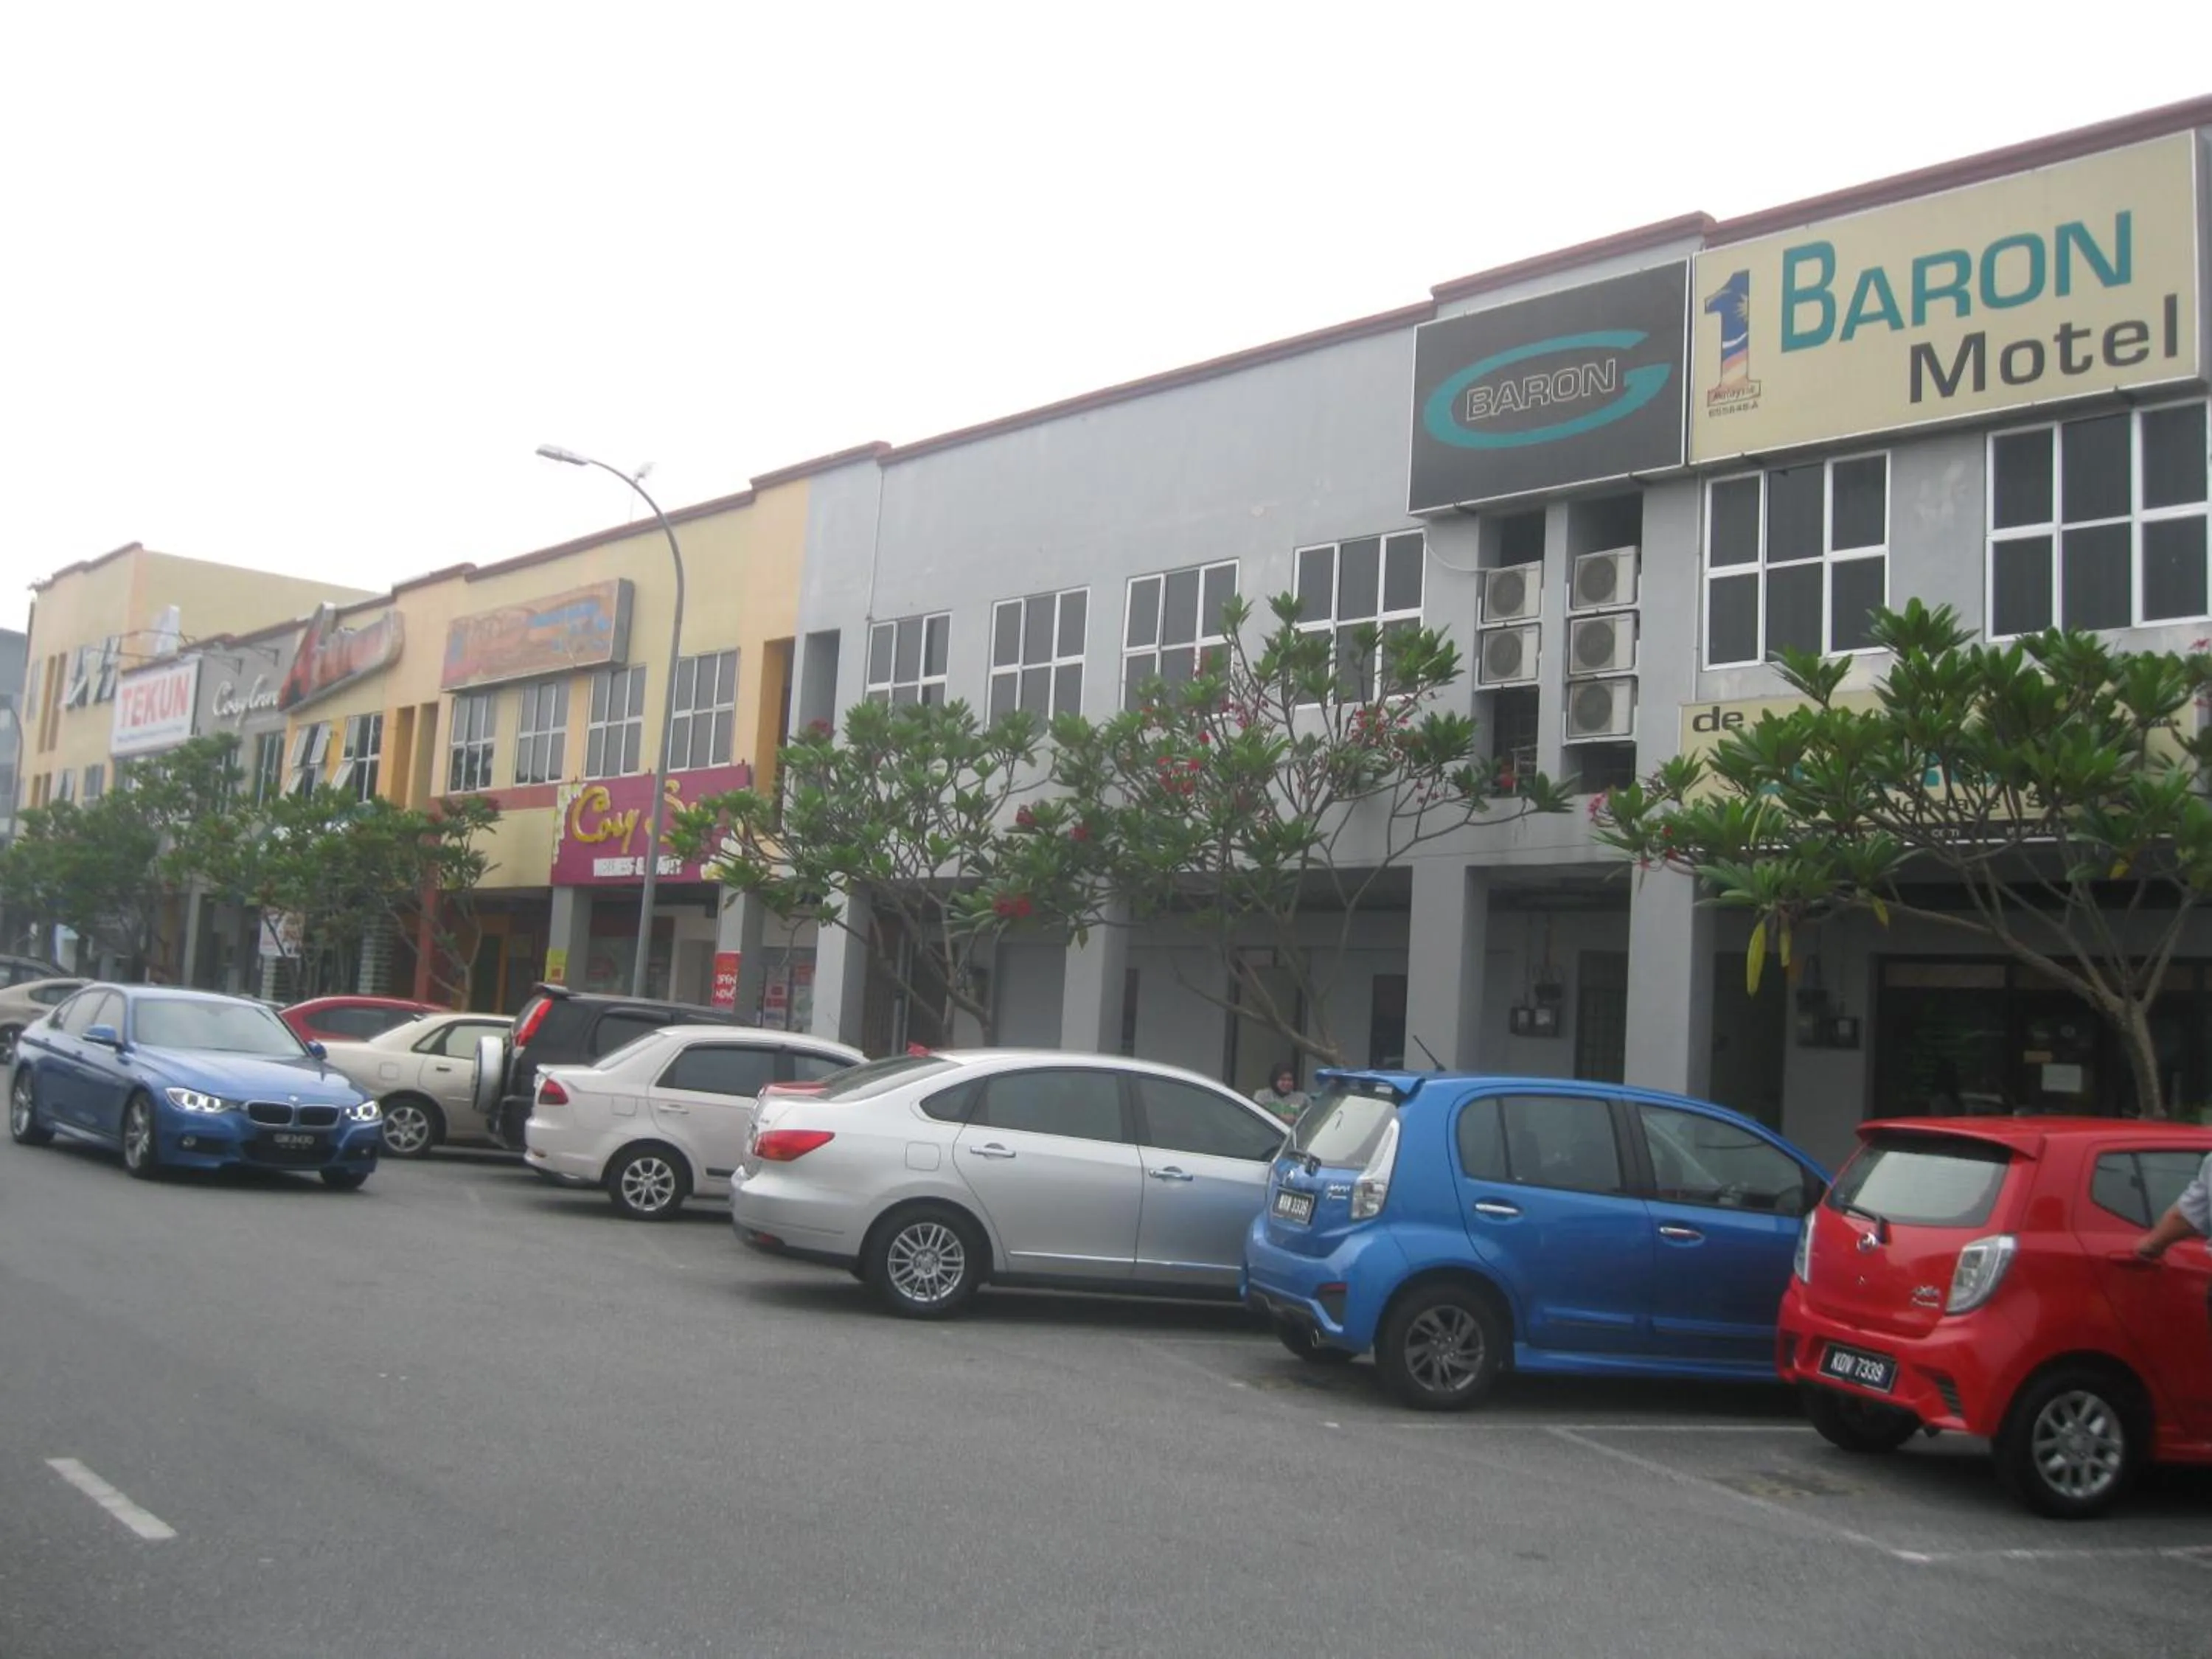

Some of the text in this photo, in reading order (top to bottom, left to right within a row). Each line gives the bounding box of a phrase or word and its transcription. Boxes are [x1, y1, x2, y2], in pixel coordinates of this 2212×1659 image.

[1781, 210, 2132, 354] BARON
[1910, 293, 2179, 403] Motel
[1466, 358, 1616, 421] BARON
[121, 672, 191, 728] TEKUN
[1691, 705, 1745, 733] de
[1854, 1357, 1885, 1383] 7339
